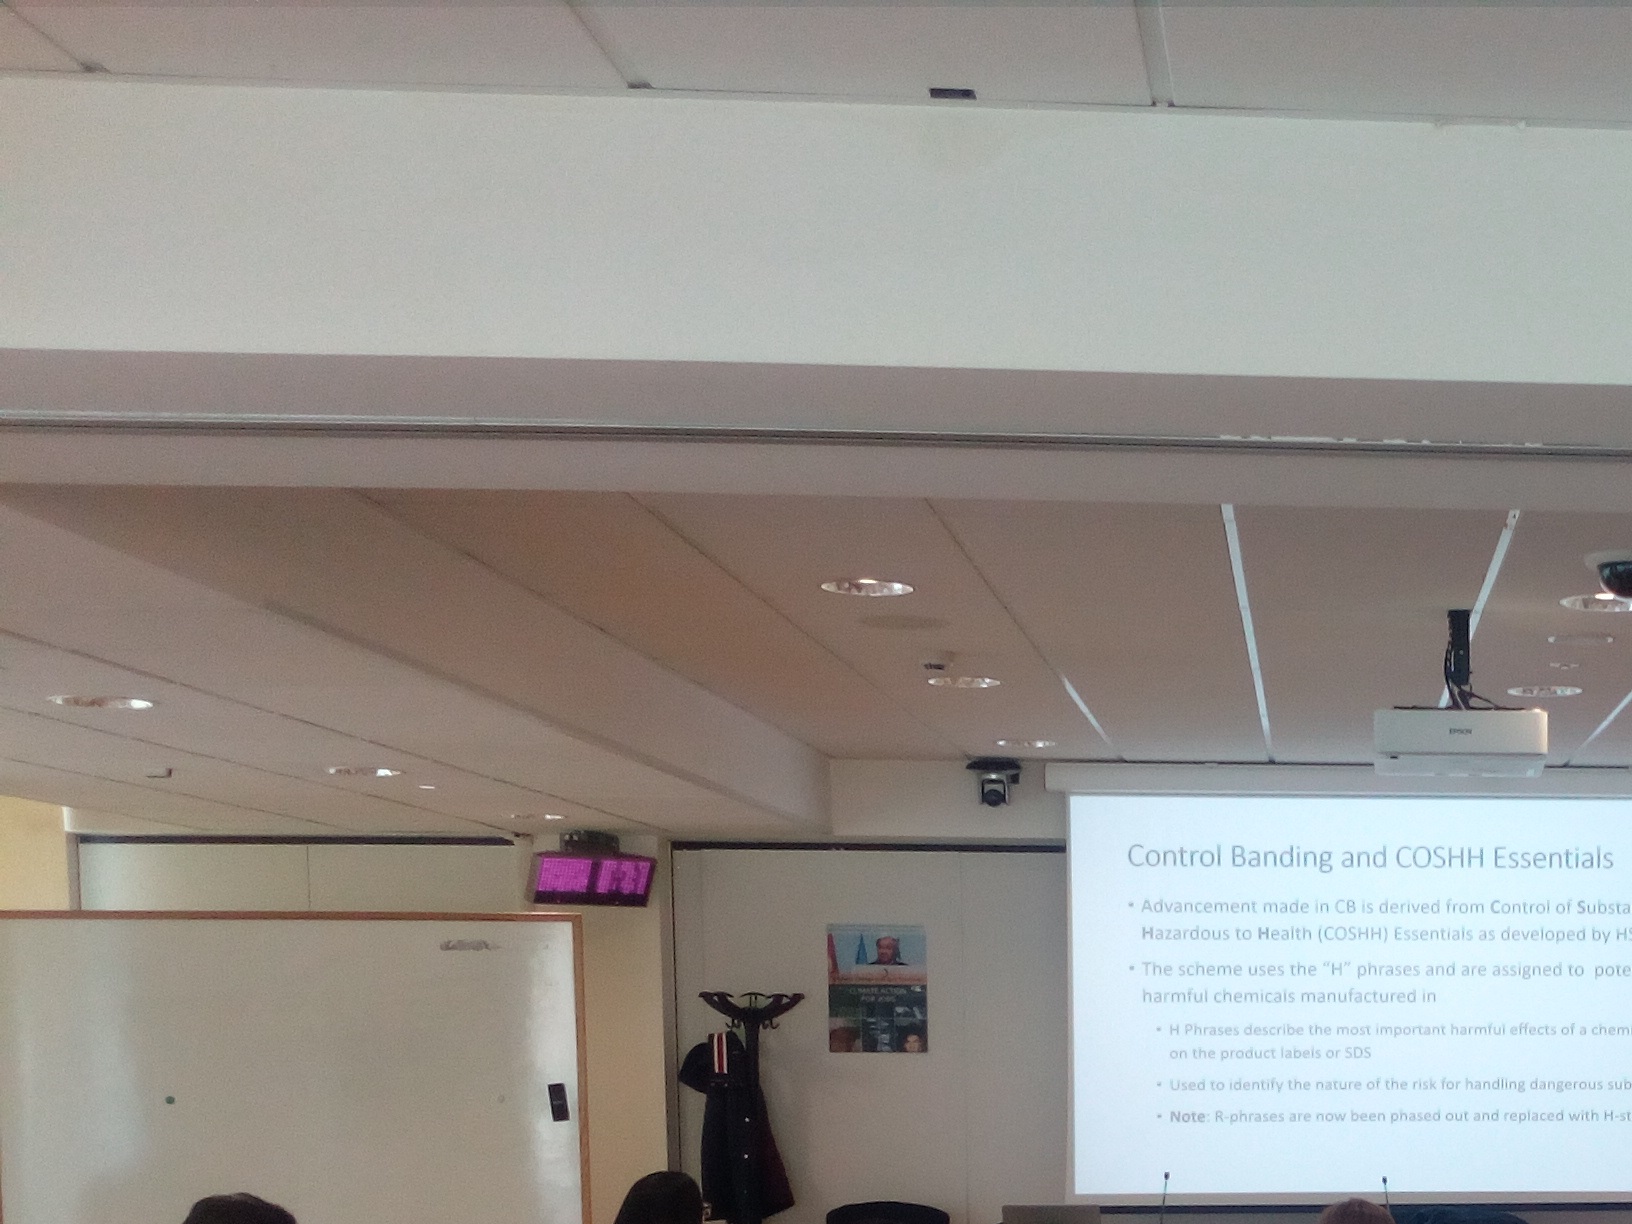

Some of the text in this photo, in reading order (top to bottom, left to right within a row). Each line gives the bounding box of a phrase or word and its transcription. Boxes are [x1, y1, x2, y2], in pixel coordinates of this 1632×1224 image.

[1449, 728, 1473, 736] EPSON
[1126, 842, 1615, 875] Control Banding and COSHH Essentials
[1140, 898, 1258, 915] Advancement
[1262, 898, 1310, 915] made
[1314, 897, 1330, 915] in
[1334, 898, 1357, 915] CB
[1361, 897, 1374, 915] is
[1378, 899, 1441, 915] derived
[1445, 898, 1485, 915] from
[1489, 898, 1551, 915] Control
[1554, 898, 1573, 915] of
[1141, 924, 1231, 942] Hazardous
[1234, 927, 1253, 941] to
[1256, 925, 1313, 942] Health
[1317, 925, 1389, 944] (COSHH)
[1393, 926, 1474, 942] Essentials
[1478, 929, 1496, 942] as
[1500, 926, 1587, 945] developed
[1591, 926, 1612, 945] by
[1141, 960, 1174, 977] The
[1177, 961, 1243, 977] scheme
[1247, 964, 1285, 977] uses
[1289, 961, 1318, 977] the
[1356, 961, 1421, 980] phrases
[1425, 961, 1457, 977] and
[1460, 964, 1488, 977] are
[1491, 961, 1563, 981] assigned
[1567, 963, 1586, 978] to
[1141, 987, 1437, 1004] harmful chemicals manufactured in
[1169, 1023, 1180, 1036] H
[1184, 1023, 1240, 1037] Phrases
[1243, 1023, 1305, 1037] describe
[1308, 1023, 1333, 1036] the
[1335, 1024, 1372, 1037] most
[1375, 1024, 1446, 1039] important
[1450, 1022, 1507, 1036] harmful
[1509, 1021, 1558, 1036] effects
[1560, 1022, 1576, 1036] of
[1578, 1025, 1588, 1036] a
[1169, 1045, 1372, 1062] on the product labels or SDS
[1169, 1078, 1207, 1092] Used
[1209, 1080, 1226, 1092] to
[1228, 1077, 1284, 1094] identify
[1287, 1078, 1312, 1092] the
[1315, 1079, 1363, 1091] nature
[1365, 1077, 1381, 1091] of
[1384, 1077, 1409, 1091] the
[1411, 1078, 1437, 1091] risk
[1440, 1076, 1462, 1091] for
[1464, 1077, 1527, 1094] handling
[1529, 1077, 1604, 1094] dangerous
[1169, 1109, 1213, 1124] Note:
[1214, 1109, 1285, 1125] R-phrases
[1288, 1112, 1312, 1123] are
[1315, 1111, 1347, 1123] now
[1350, 1109, 1387, 1123] been
[1389, 1109, 1442, 1125] phased
[1444, 1110, 1469, 1123] out
[1472, 1108, 1500, 1122] and
[1503, 1109, 1565, 1125] replaced
[1567, 1108, 1600, 1122] with
